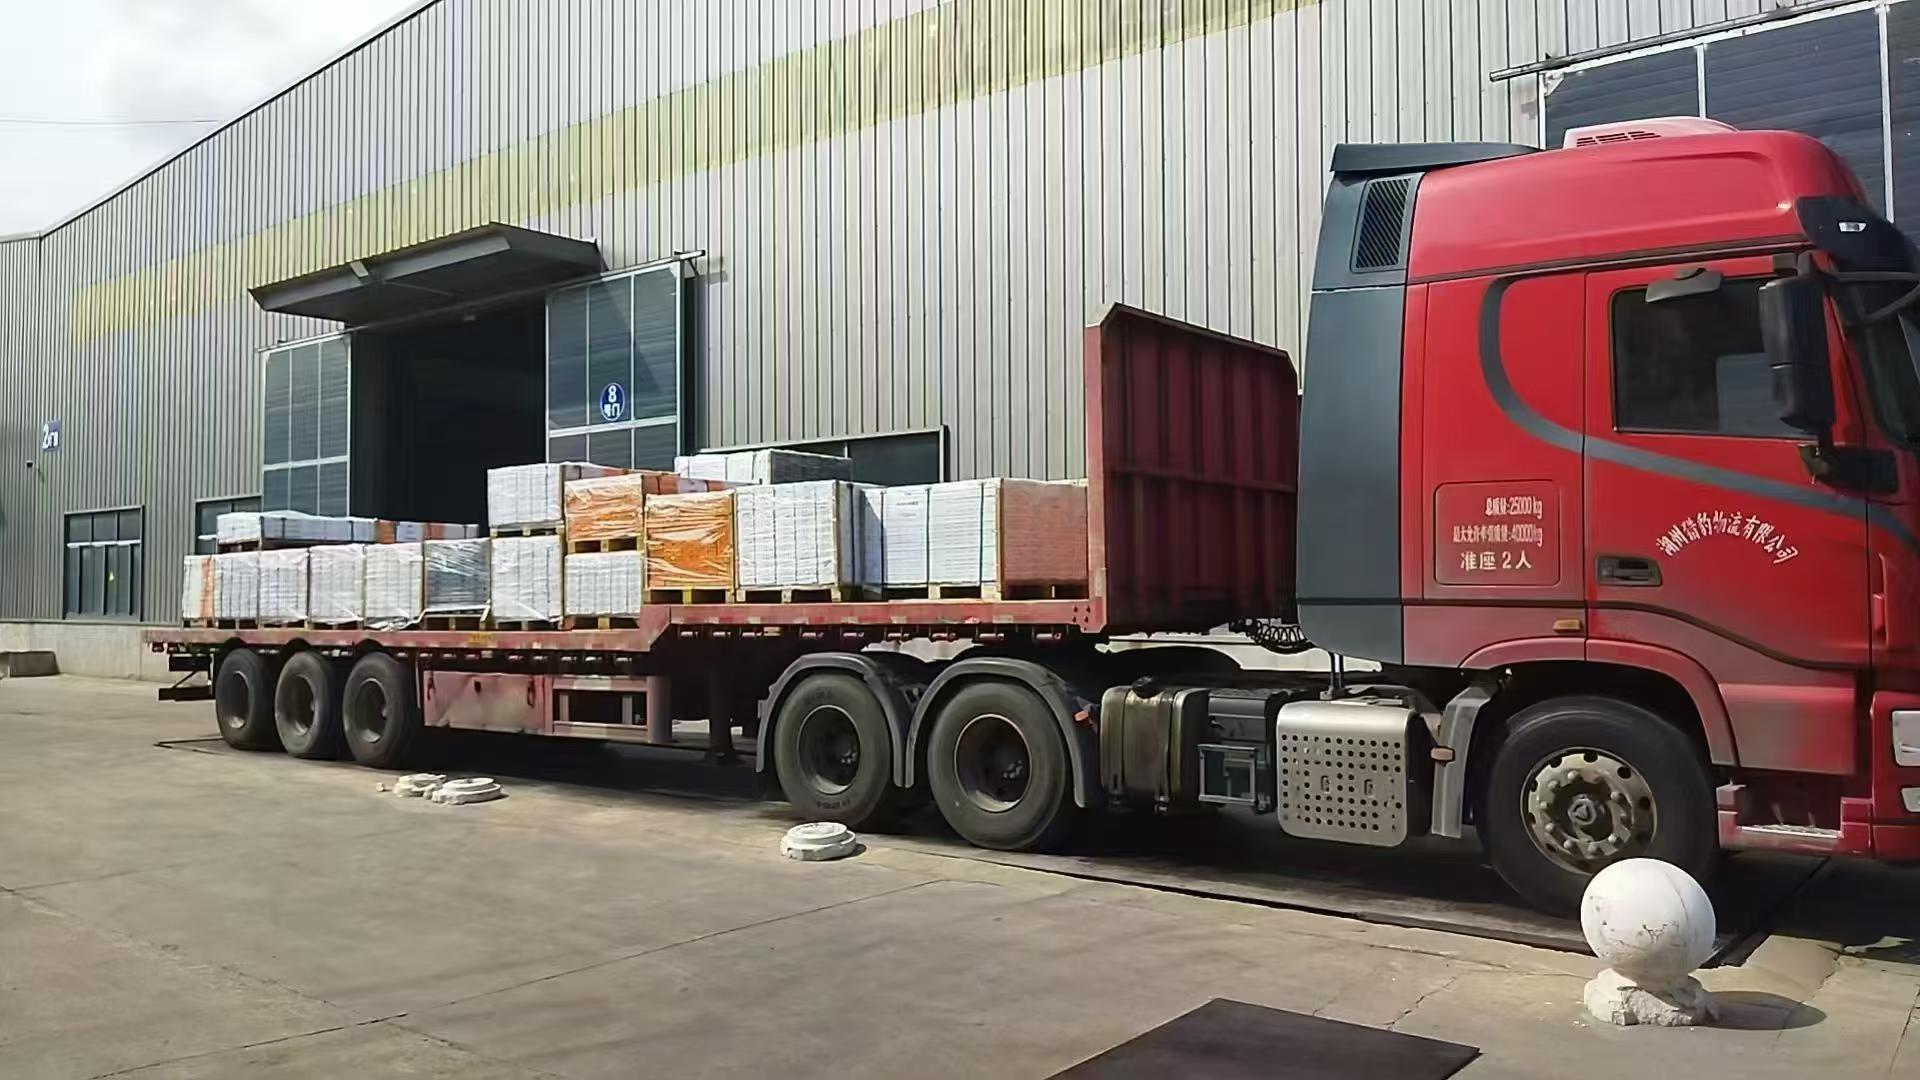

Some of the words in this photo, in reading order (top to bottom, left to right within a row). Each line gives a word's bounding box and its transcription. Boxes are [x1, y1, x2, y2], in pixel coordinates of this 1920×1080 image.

[608, 385, 617, 403] 8
[1460, 551, 1532, 571] 准座2人
